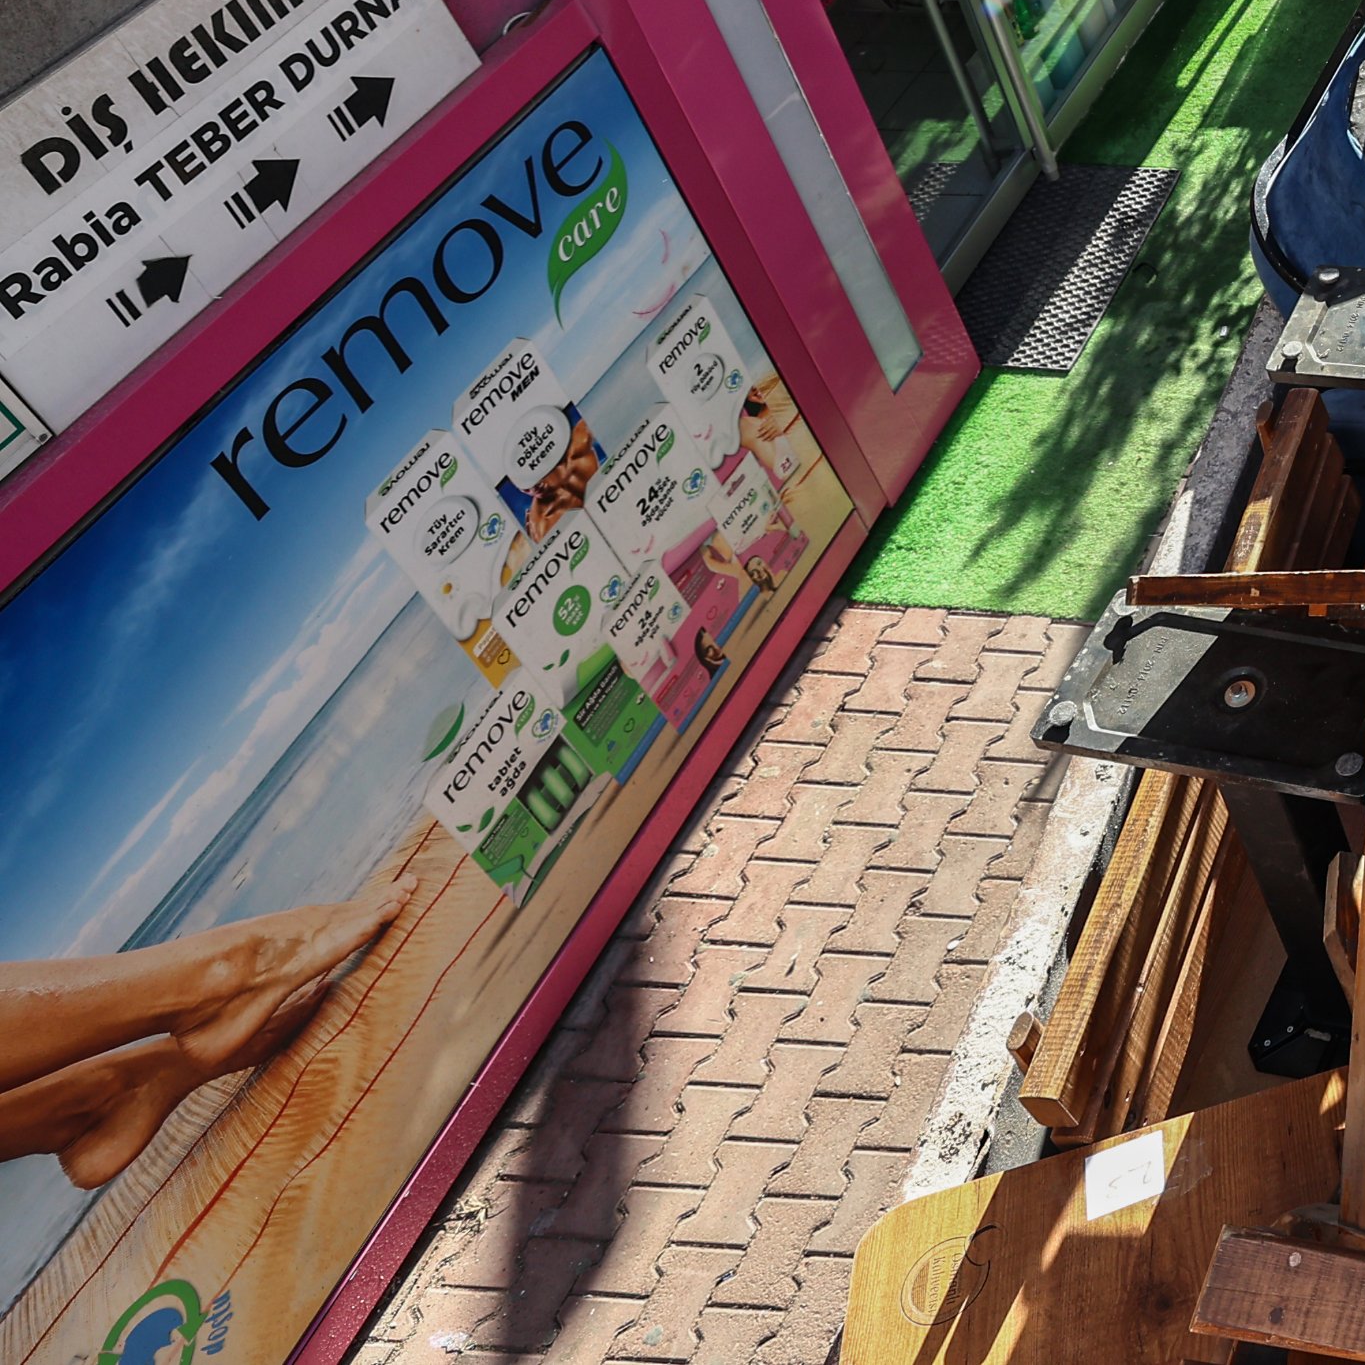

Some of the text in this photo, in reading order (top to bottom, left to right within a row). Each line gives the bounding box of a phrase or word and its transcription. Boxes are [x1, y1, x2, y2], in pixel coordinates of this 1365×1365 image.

[21, 106, 133, 196] DİŞ
[0, 201, 142, 320] Rabia
[134, 79, 286, 202] TEBER
[557, 186, 623, 263] care
[210, 119, 604, 522] remove
[658, 316, 706, 374] remove
[511, 365, 540, 402] MEN
[693, 363, 703, 376] 2
[460, 352, 535, 435] remove
[517, 423, 554, 467] Dökücü
[518, 426, 539, 448] Tüy
[529, 440, 555, 470] Krem
[597, 423, 668, 514] remove
[380, 452, 453, 534] remove
[636, 485, 660, 516] 24
[425, 510, 466, 556] Sarartıcı
[428, 513, 447, 535] Tüy
[438, 526, 464, 556] Krem
[505, 530, 582, 629] remove
[558, 597, 575, 620] 52
[609, 575, 655, 637] remove
[639, 610, 652, 629] 24
[443, 690, 529, 804] remove
[487, 746, 522, 792] tablet
[500, 760, 527, 797] ağda
